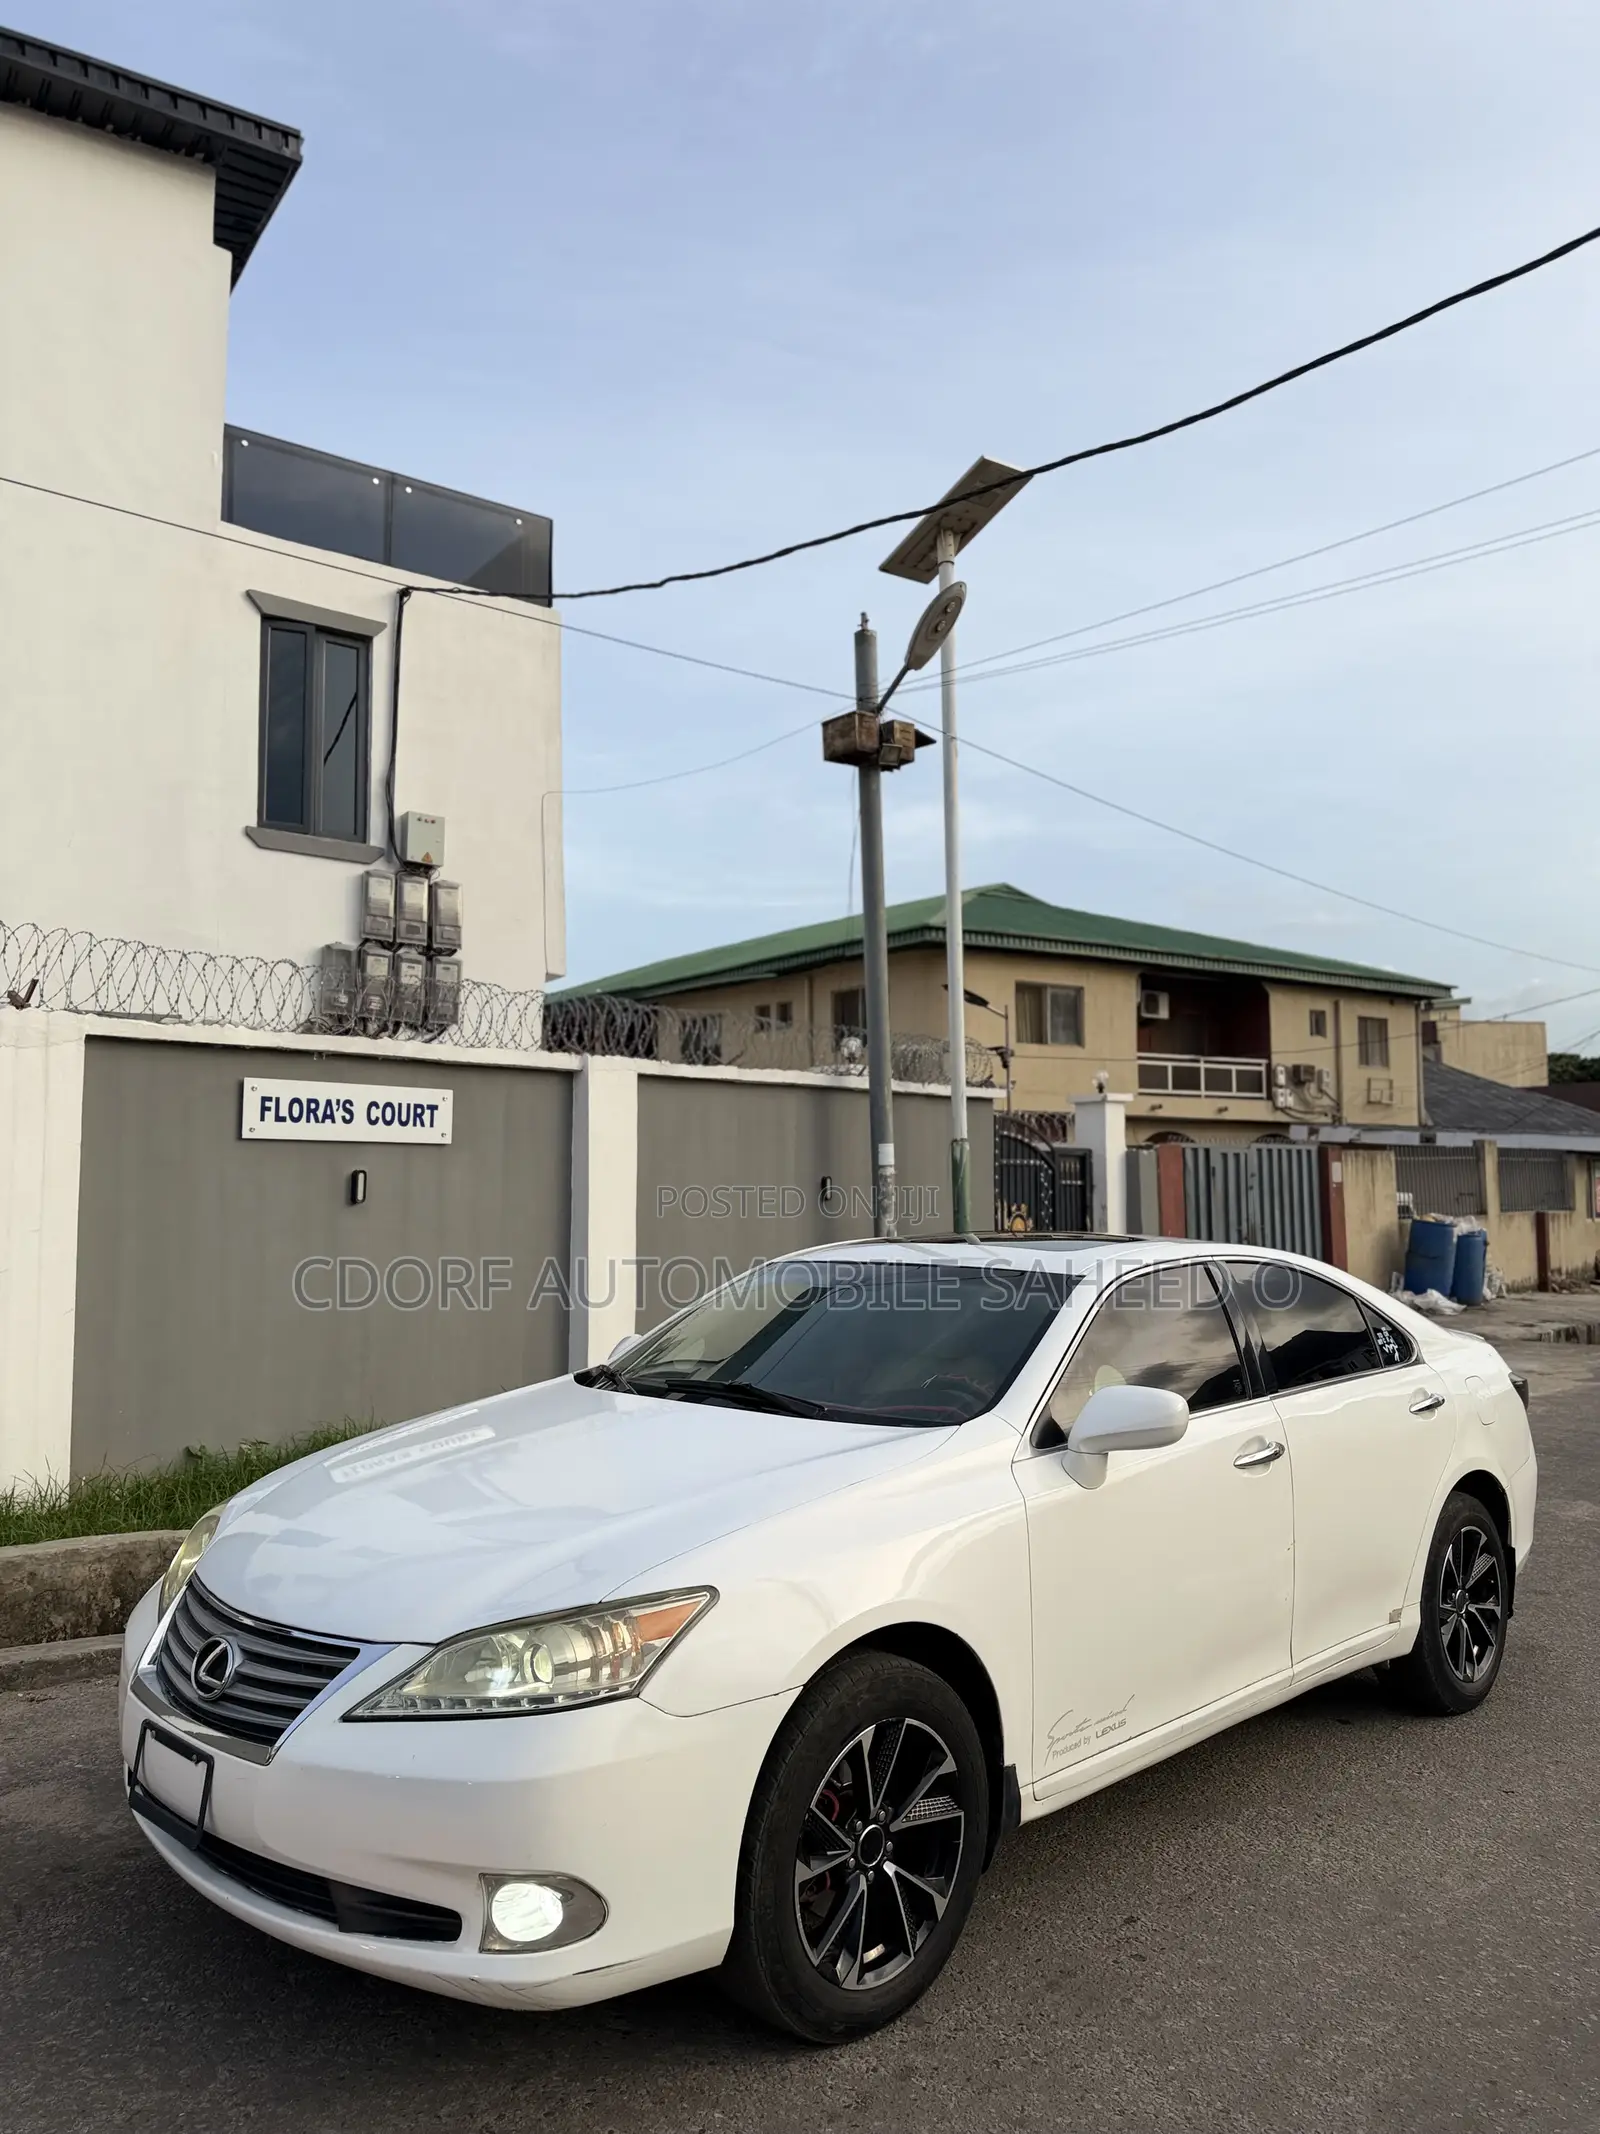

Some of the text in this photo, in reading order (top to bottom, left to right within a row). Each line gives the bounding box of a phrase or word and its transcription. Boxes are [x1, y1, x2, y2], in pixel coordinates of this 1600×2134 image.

[260, 1096, 438, 1127] FLORA'S COURT
[1052, 1718, 1127, 1760] Produced by LEXUS
